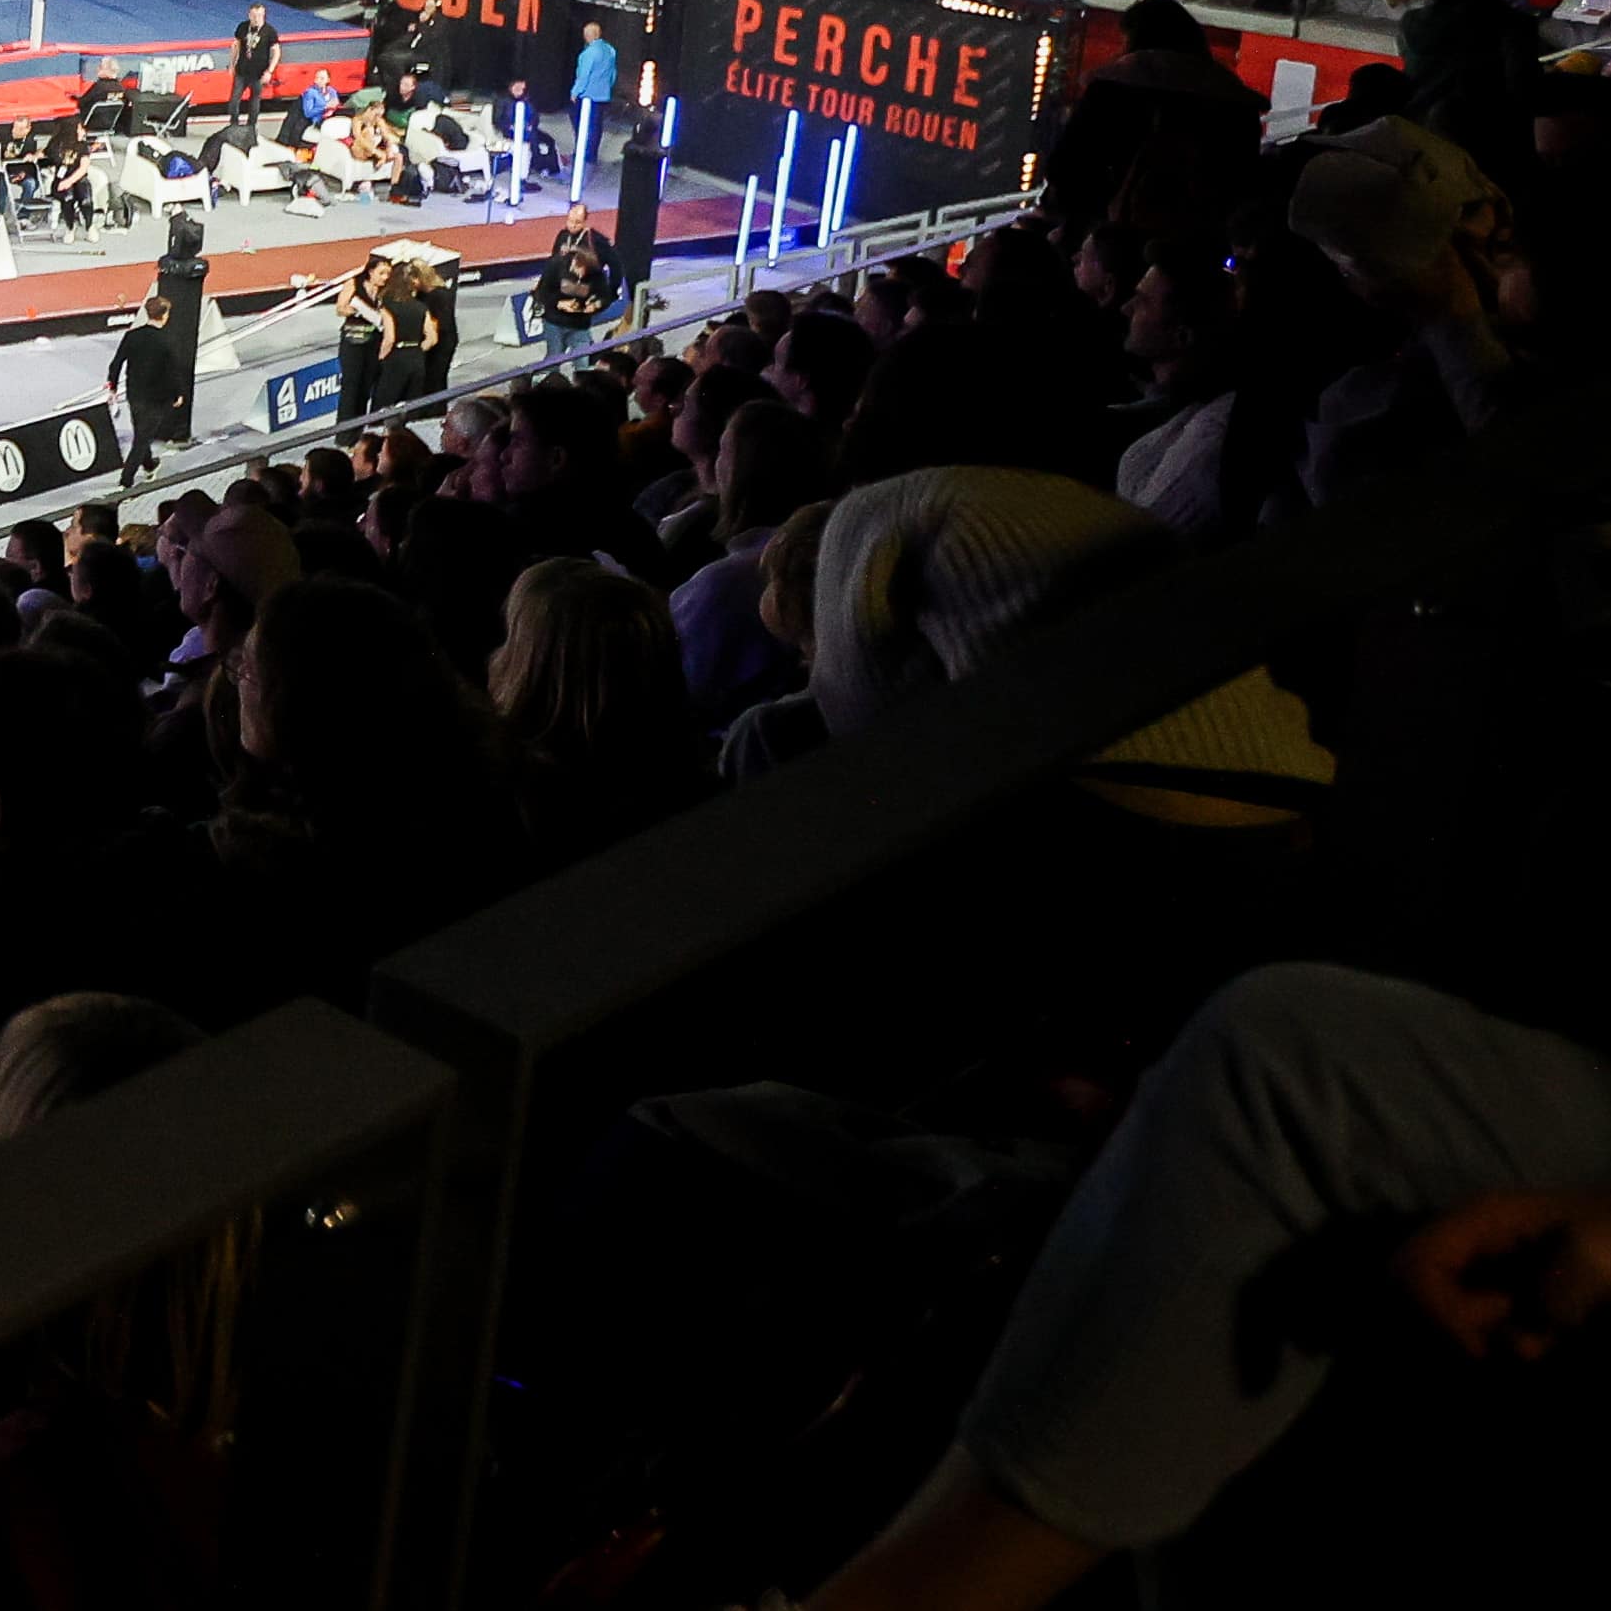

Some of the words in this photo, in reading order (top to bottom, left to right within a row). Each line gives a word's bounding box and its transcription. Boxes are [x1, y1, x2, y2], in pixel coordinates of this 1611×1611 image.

[725, 58, 796, 109] ÉLITE
[807, 83, 875, 127] TOUR
[885, 102, 978, 151] ROUEN
[304, 377, 342, 403] ATHL
